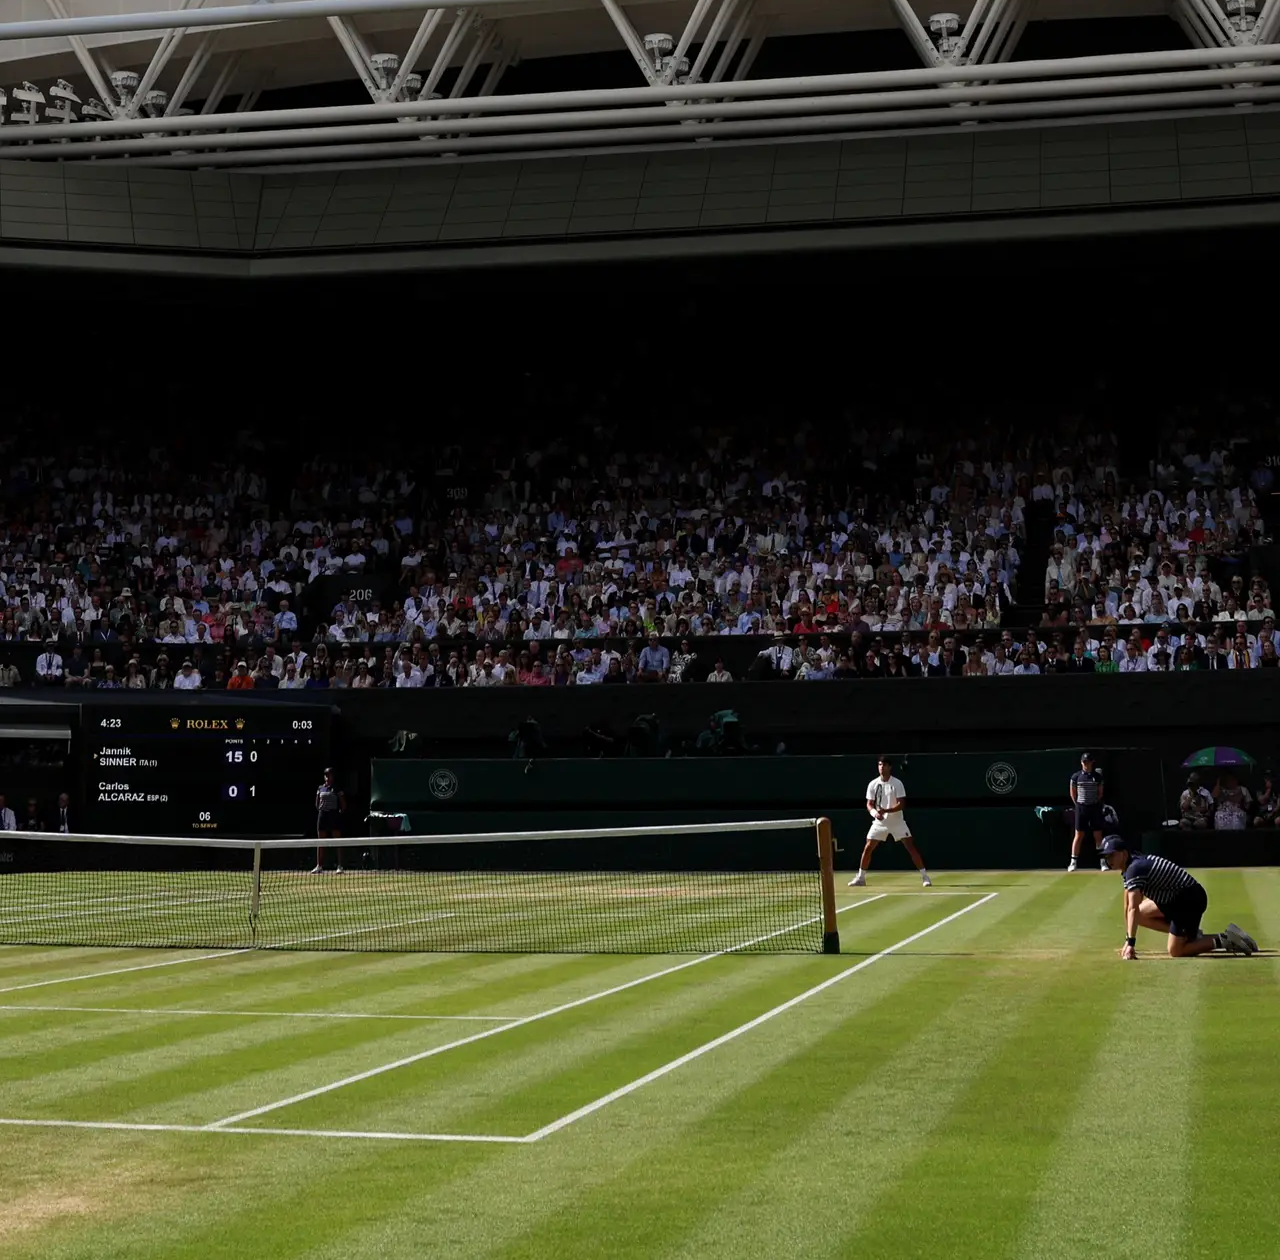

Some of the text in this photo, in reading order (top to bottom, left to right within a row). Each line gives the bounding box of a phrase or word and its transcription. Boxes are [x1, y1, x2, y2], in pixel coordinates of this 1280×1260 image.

[445, 487, 468, 500] 309
[348, 588, 373, 602] 206
[101, 719, 312, 729] 4:23 ROLEX 0:03
[100, 747, 257, 762] Jannik 15 0
[100, 758, 136, 766] SINNER
[99, 782, 255, 797] Carlos 0 1
[98, 793, 144, 801] ALCARAZ
[199, 812, 210, 820] 06
